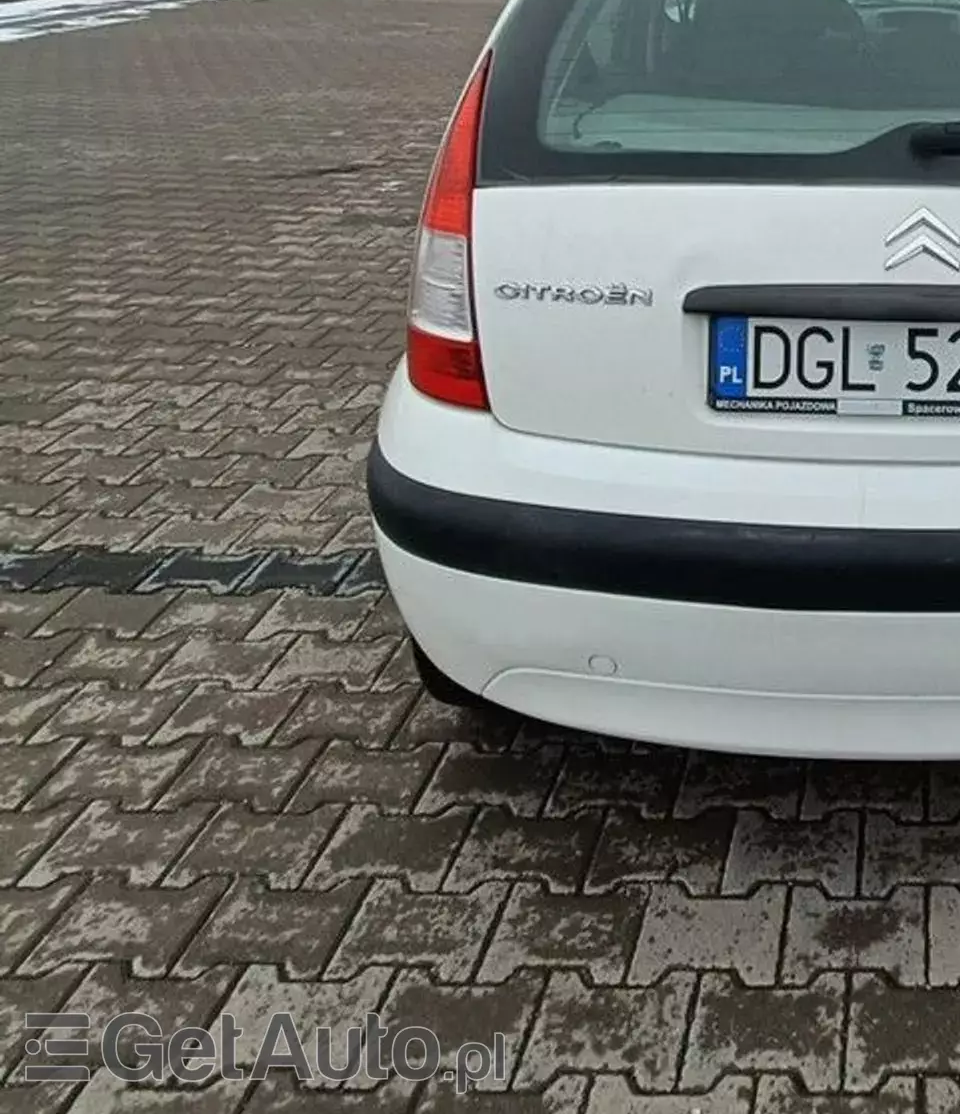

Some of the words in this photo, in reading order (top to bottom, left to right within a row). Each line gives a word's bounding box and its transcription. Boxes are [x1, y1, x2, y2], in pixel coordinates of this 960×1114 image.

[494, 281, 653, 307] CITROËN
[753, 325, 876, 391] DGL
[719, 365, 743, 384] PL
[716, 399, 773, 411] MECHANIKA
[775, 400, 837, 412] POJAZDOWA
